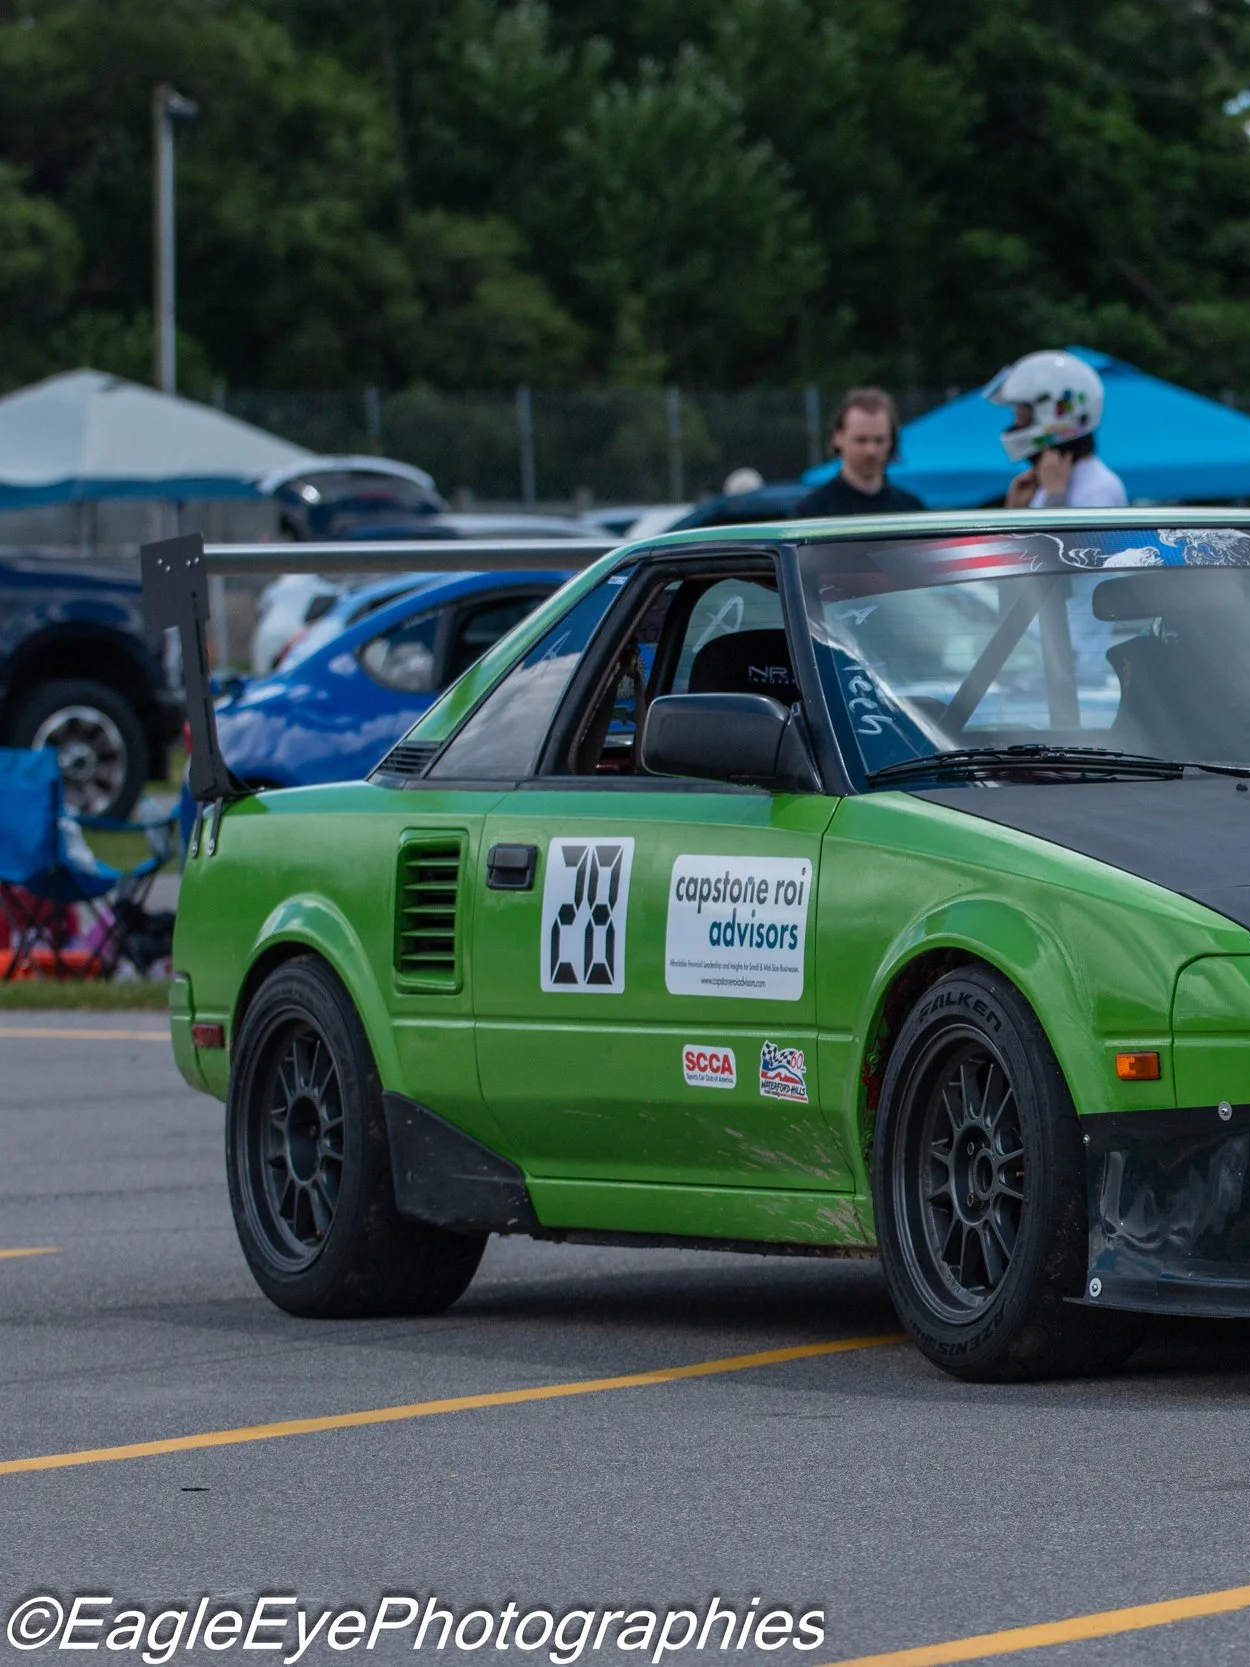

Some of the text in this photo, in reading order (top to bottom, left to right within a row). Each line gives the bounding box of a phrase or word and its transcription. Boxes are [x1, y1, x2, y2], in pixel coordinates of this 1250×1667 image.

[675, 866, 806, 914] capstone roi
[550, 845, 624, 985] 28
[708, 907, 799, 951] advisors
[918, 991, 1002, 1033] FALKEN
[685, 1051, 733, 1075] SCCA
[705, 1074, 714, 1082] Club
